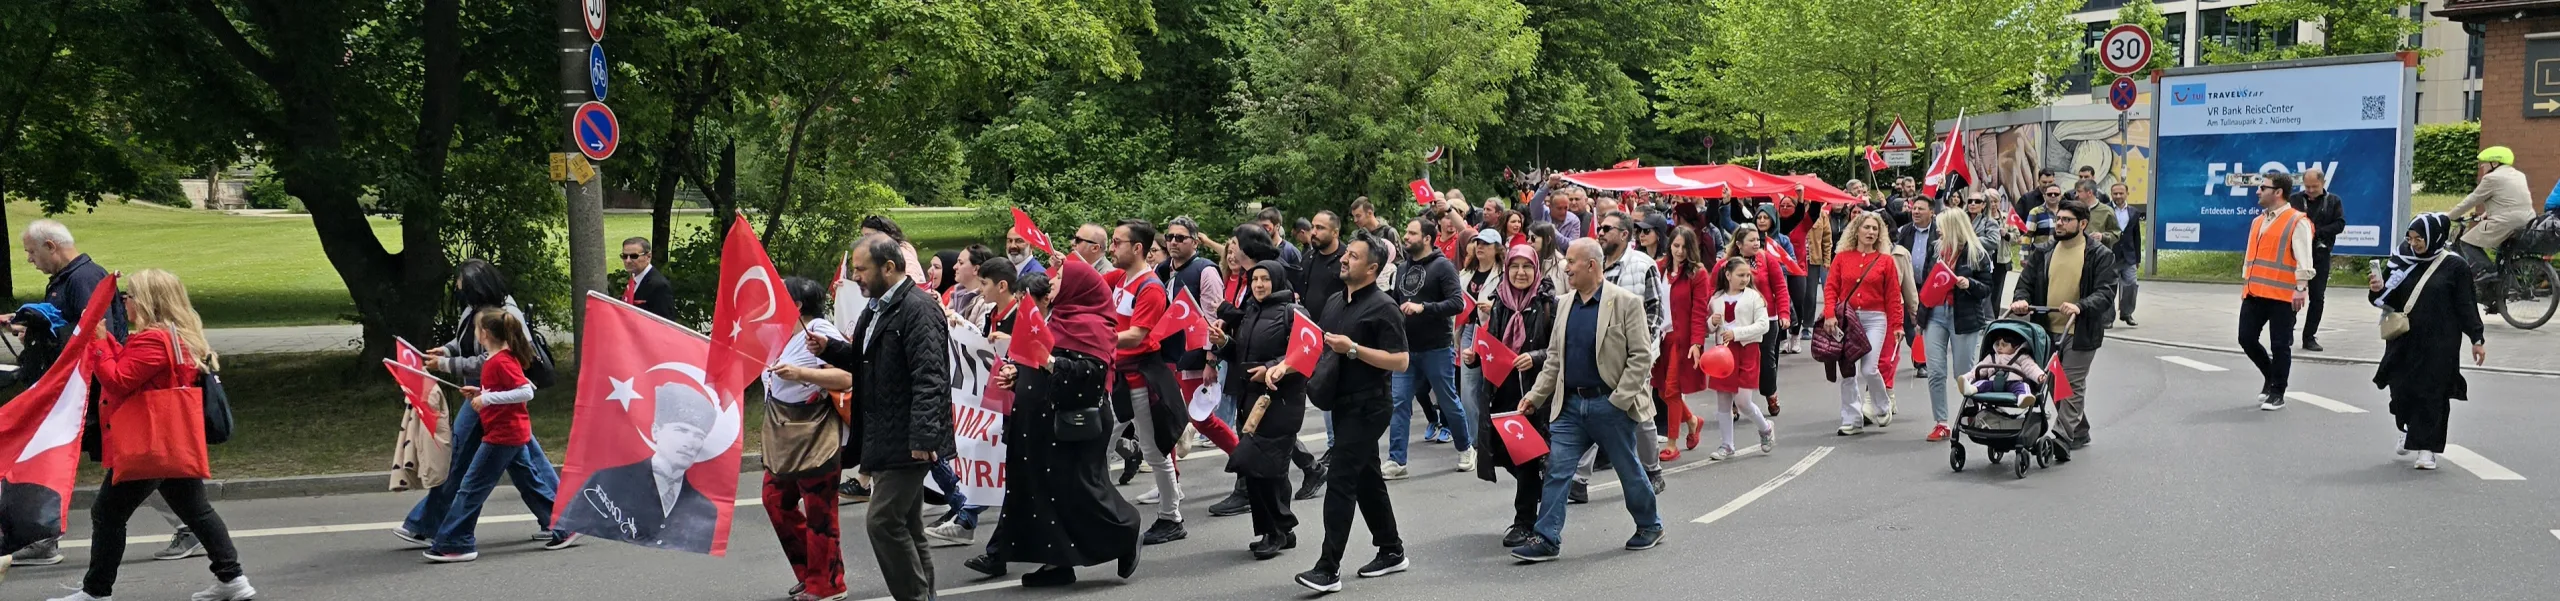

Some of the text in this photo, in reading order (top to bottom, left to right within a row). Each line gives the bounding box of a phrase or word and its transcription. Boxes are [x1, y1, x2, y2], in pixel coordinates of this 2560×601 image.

[2111, 38, 2140, 60] 30
[2207, 103, 2294, 116] VR Bank ReiseCenter
[2207, 119, 2219, 127] Am
[2221, 117, 2257, 127] Tullnaupark
[2259, 117, 2264, 125] 2
[2269, 116, 2301, 125] Nürnberg
[581, 186, 588, 195] 2
[2201, 207, 2235, 215] Entdecken
[2236, 207, 2248, 215] Sie
[2249, 207, 2260, 215] die
[952, 403, 998, 447] NMA,
[954, 457, 1006, 488] AYRA
